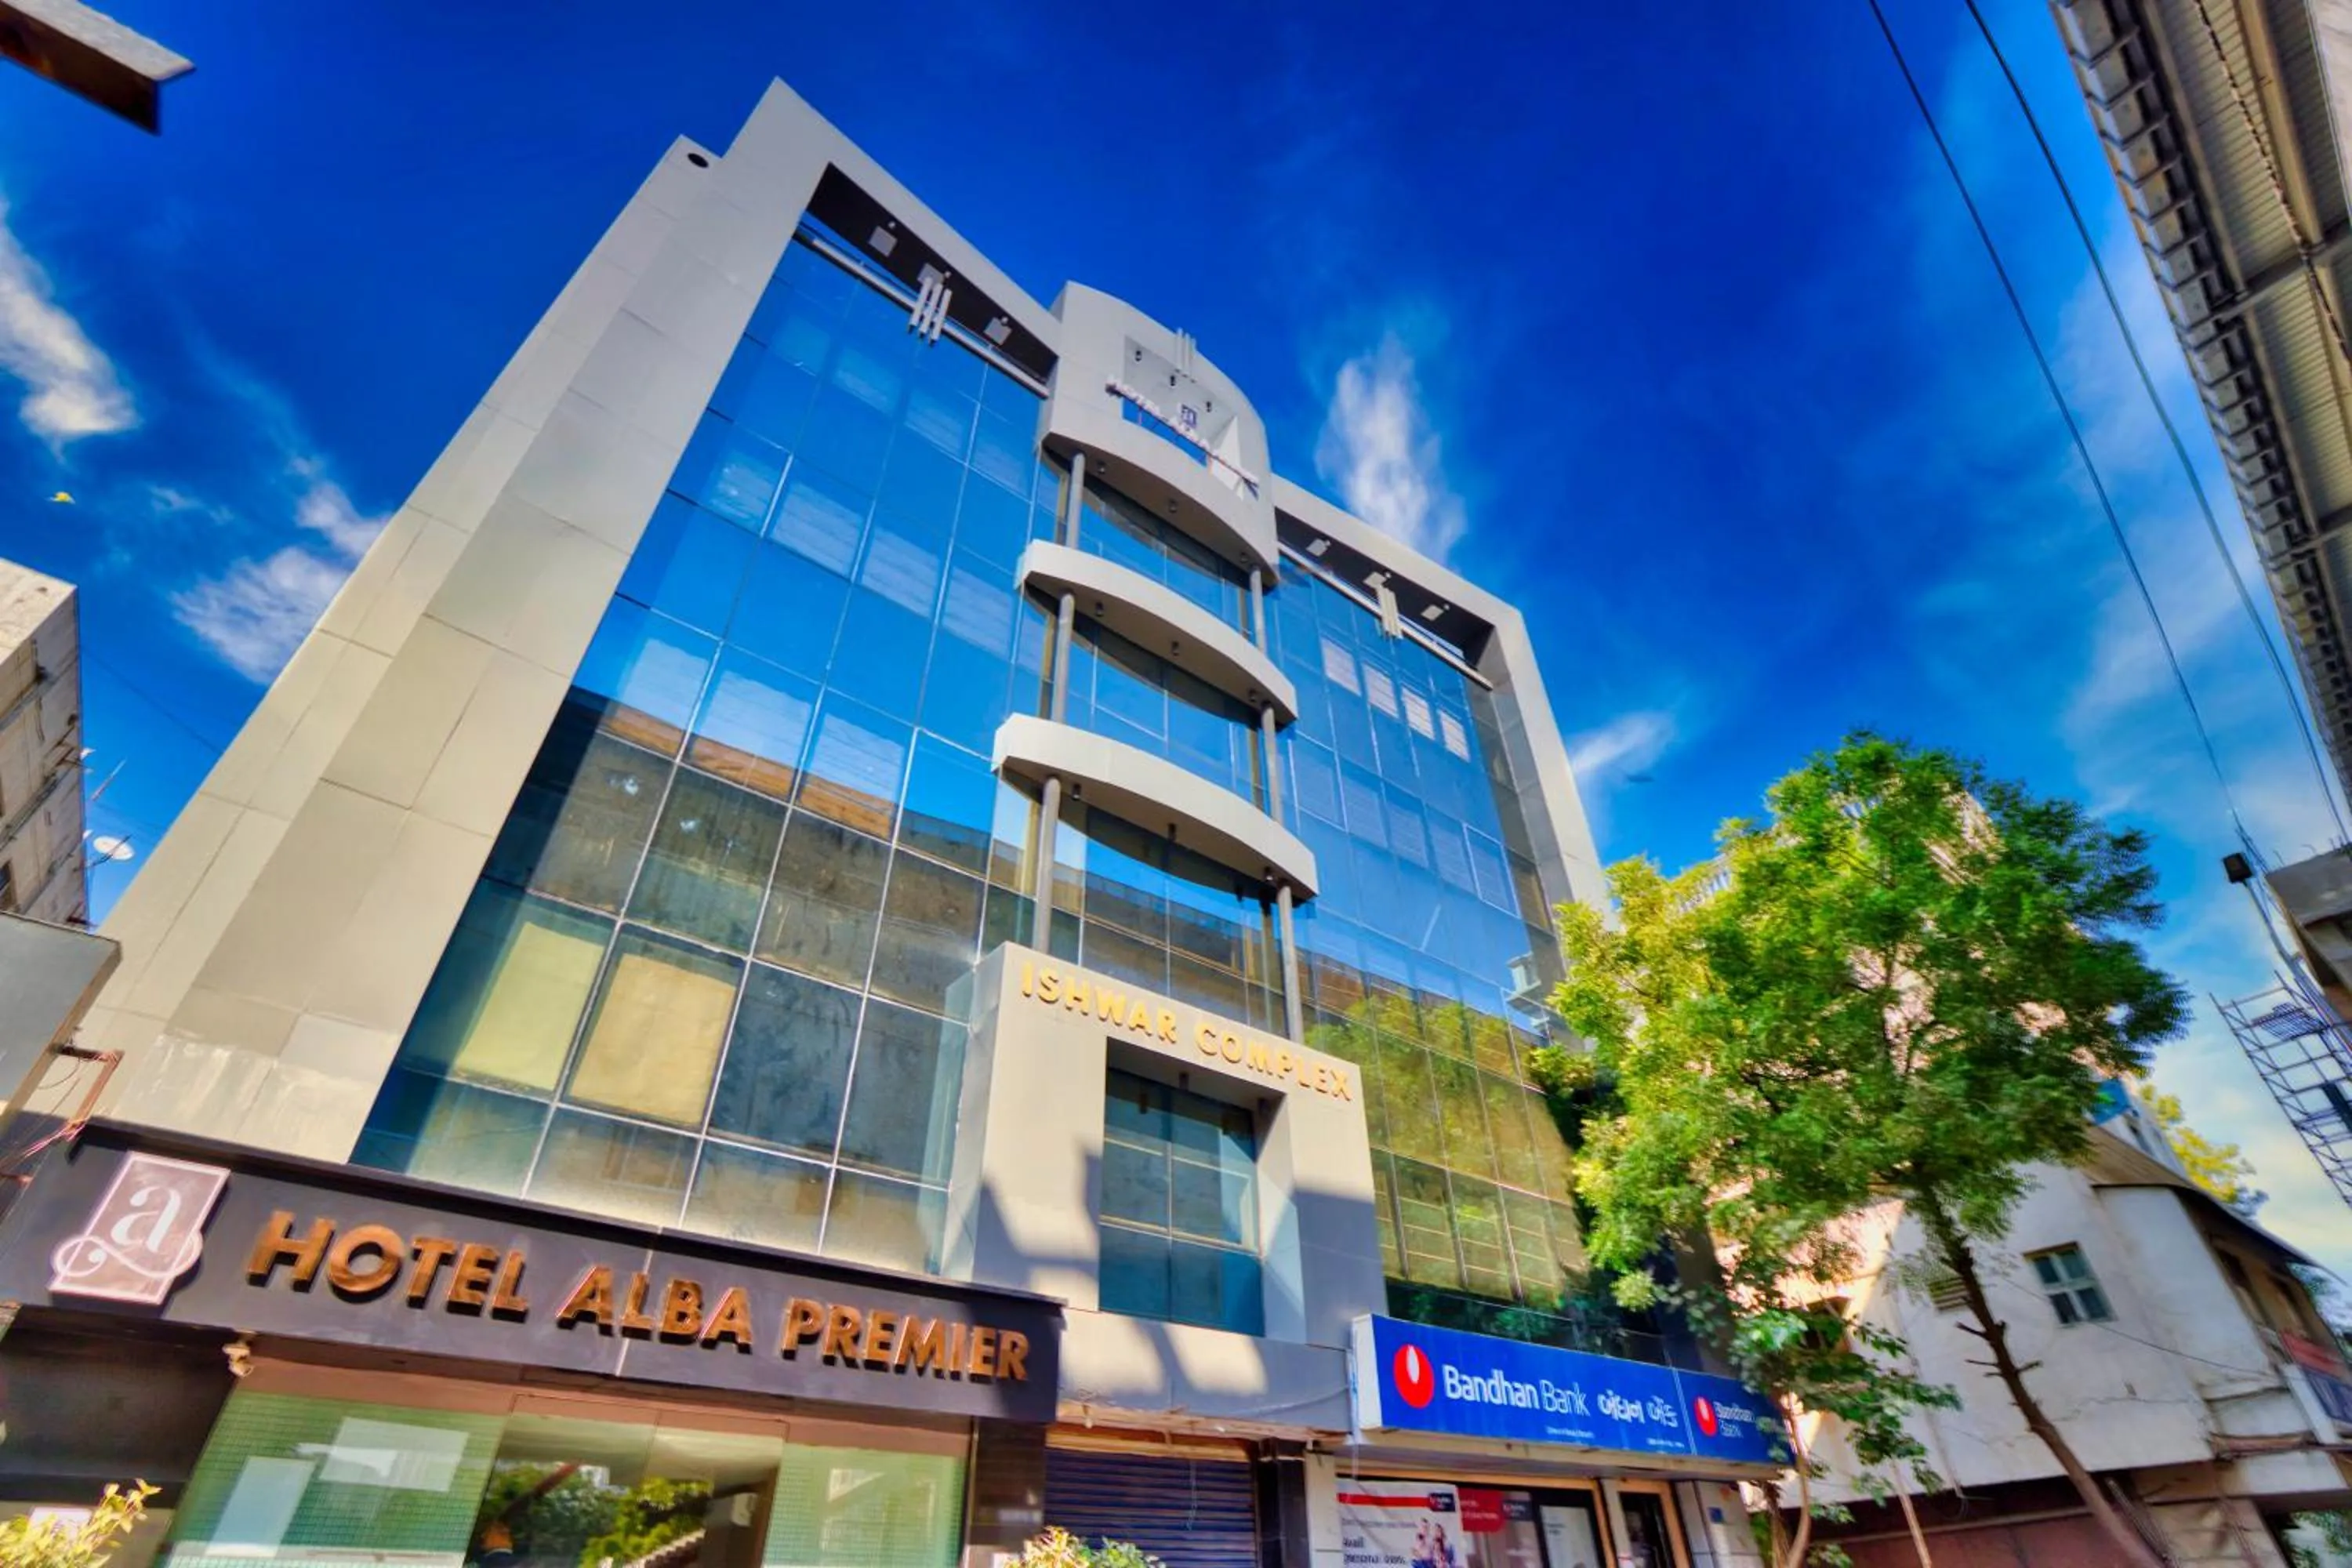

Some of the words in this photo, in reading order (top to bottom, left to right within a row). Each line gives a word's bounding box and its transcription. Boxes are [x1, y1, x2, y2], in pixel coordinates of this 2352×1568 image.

[1022, 961, 1176, 1044] ISHWAR
[1196, 1024, 1351, 1102] COMPLEX
[246, 1210, 530, 1323] HOTEL
[556, 1265, 752, 1354] ALBA
[782, 1298, 1030, 1381] PREMIER
[1443, 1364, 1539, 1410] Bandhan
[1542, 1381, 1590, 1417] Bank
